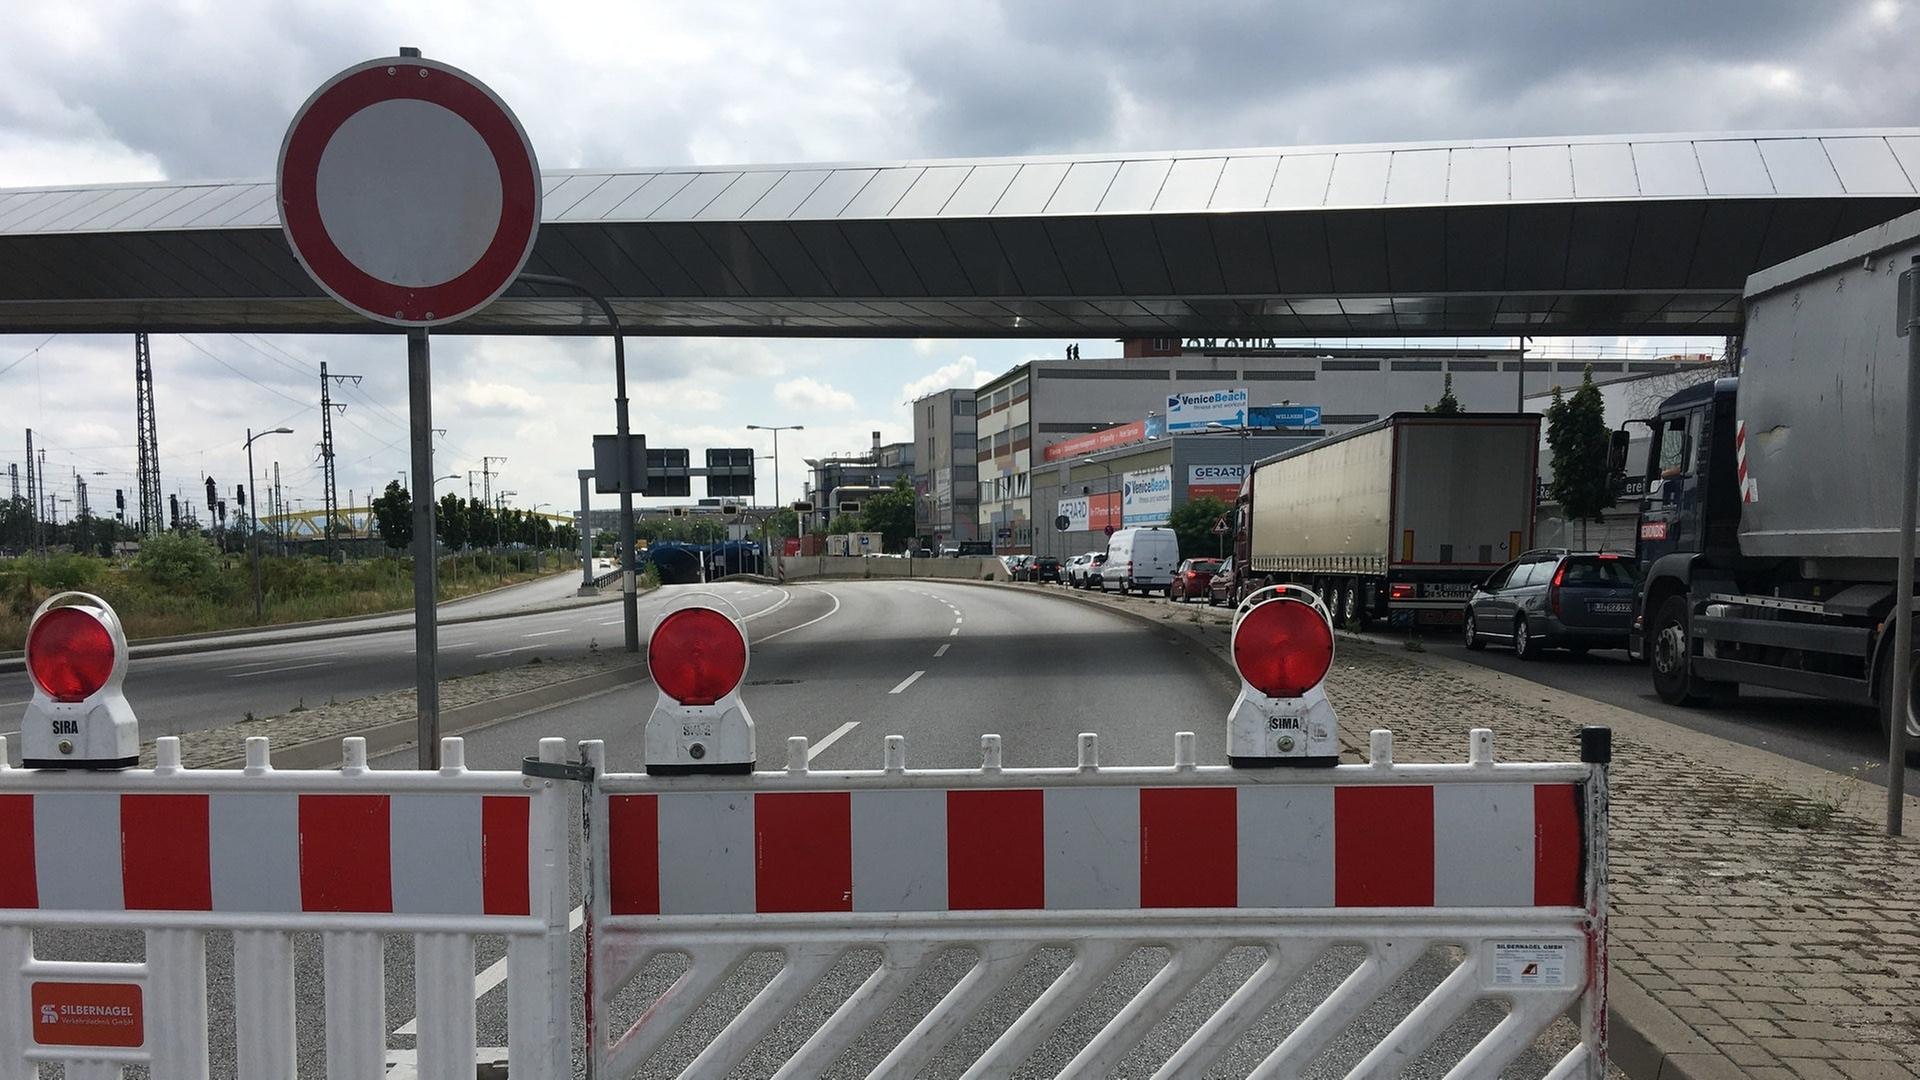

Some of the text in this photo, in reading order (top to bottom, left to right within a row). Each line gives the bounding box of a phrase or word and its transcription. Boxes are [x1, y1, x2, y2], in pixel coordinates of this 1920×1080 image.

[1182, 391, 1246, 405] VeniceBeach
[1195, 467, 1245, 477] GERARD
[52, 720, 78, 735] SIRA
[1271, 718, 1299, 730] SIMA
[61, 1005, 133, 1016] SILBERNAGEL
[61, 1017, 134, 1026] Verkehrstechnik GmbH
